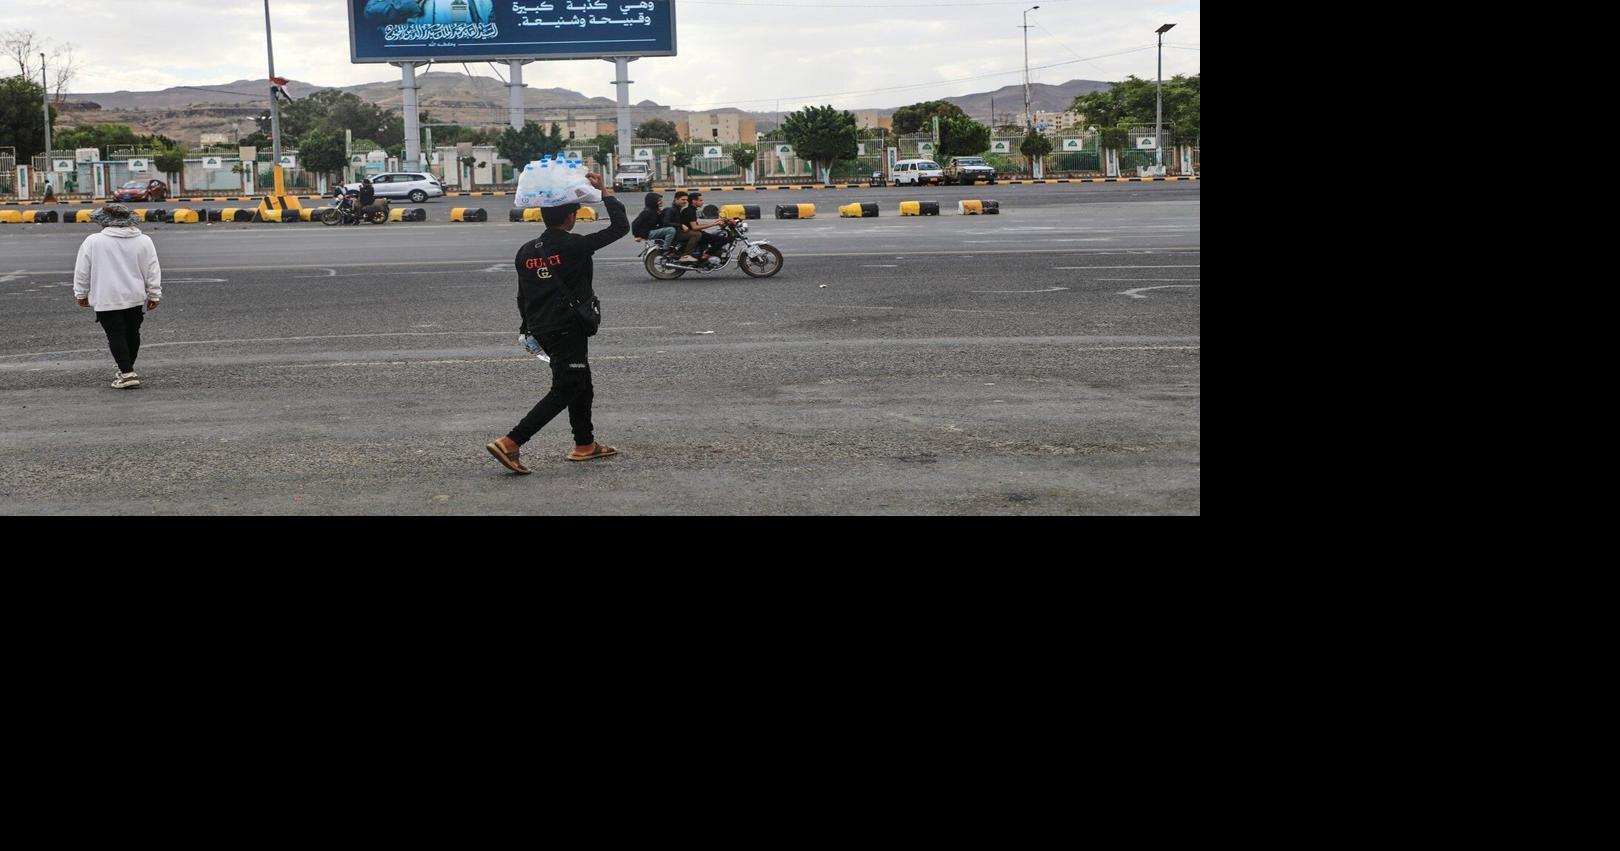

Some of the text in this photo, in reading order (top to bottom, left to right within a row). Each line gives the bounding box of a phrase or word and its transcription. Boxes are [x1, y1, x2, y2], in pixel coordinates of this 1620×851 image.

[511, 0, 655, 15] وهي كذبة كبيرة
[517, 12, 652, 28] وقبيحة وشنيعة.
[525, 254, 562, 269] GUCI
